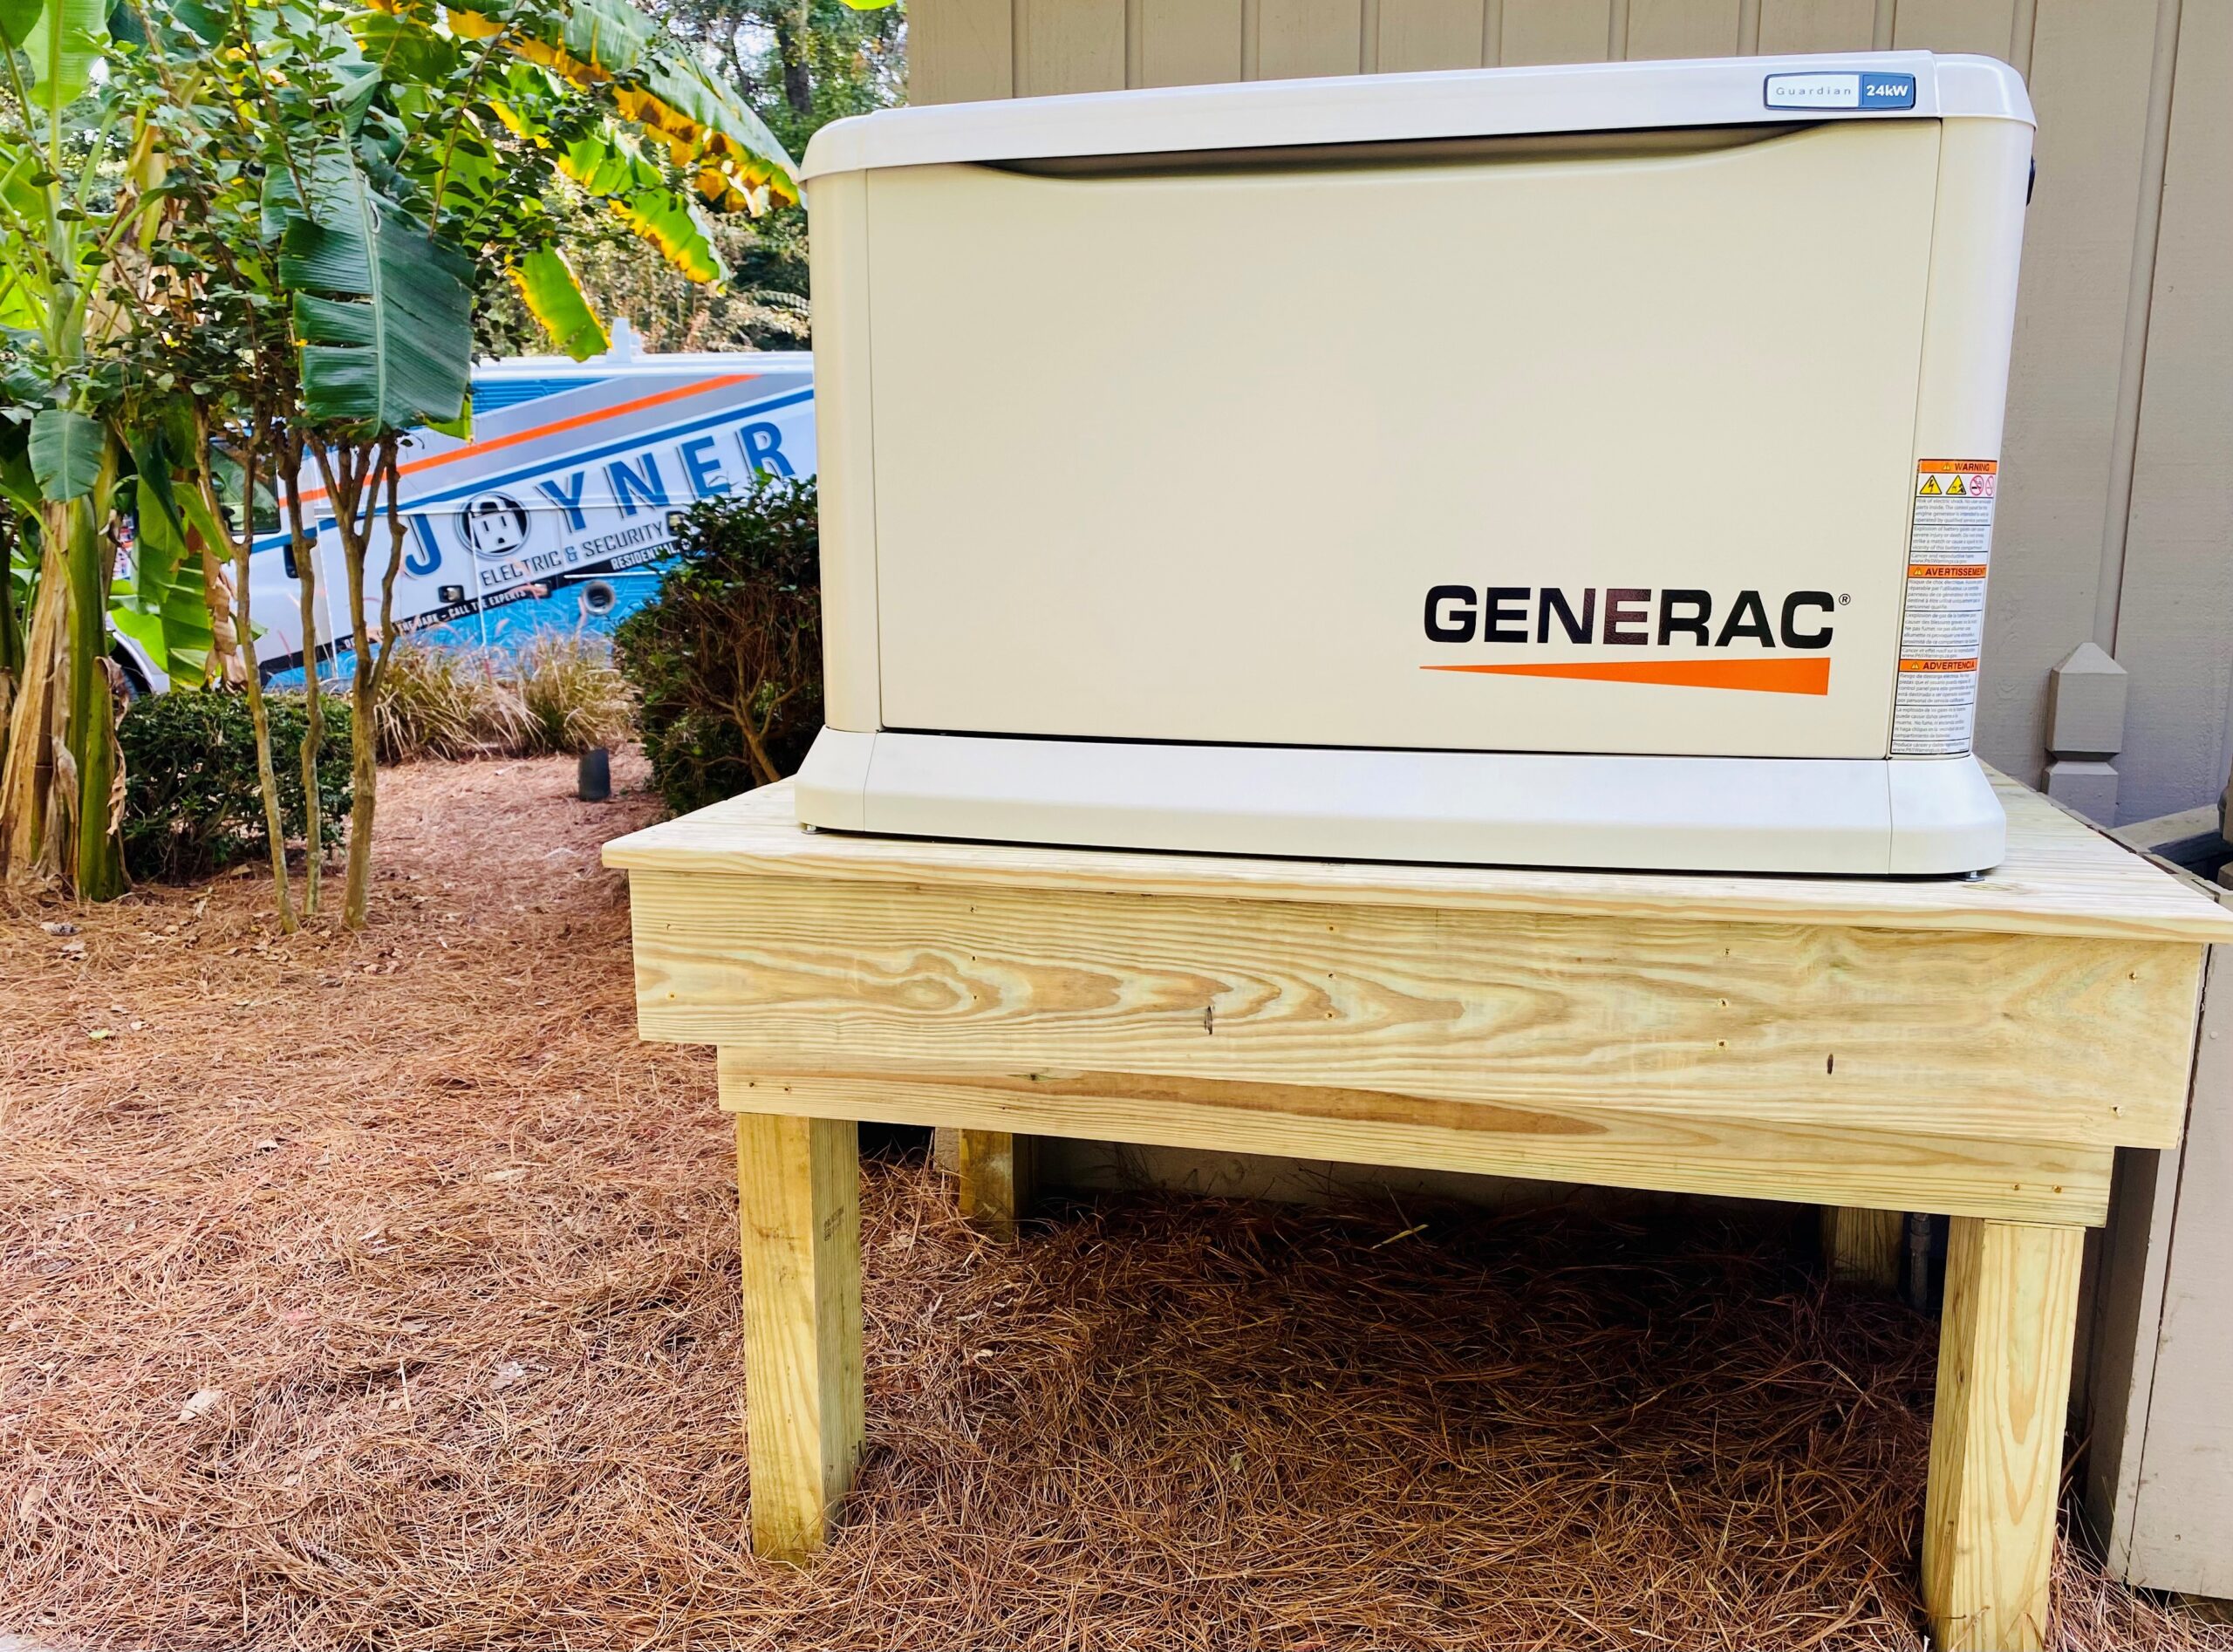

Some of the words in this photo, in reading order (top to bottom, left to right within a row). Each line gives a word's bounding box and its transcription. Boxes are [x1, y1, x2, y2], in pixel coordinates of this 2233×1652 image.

[1776, 86, 1851, 96] Guardian
[1867, 85, 1908, 97] 24kW
[1954, 462, 1990, 472] WARNING
[481, 550, 561, 586] ELECTRIC
[565, 545, 578, 563] &
[582, 522, 663, 557] SECURITY
[447, 605, 470, 618] CALL
[470, 598, 488, 611] TE
[1424, 584, 1835, 650] GENERAC
[1922, 661, 1975, 670] ADVERTENCIA
